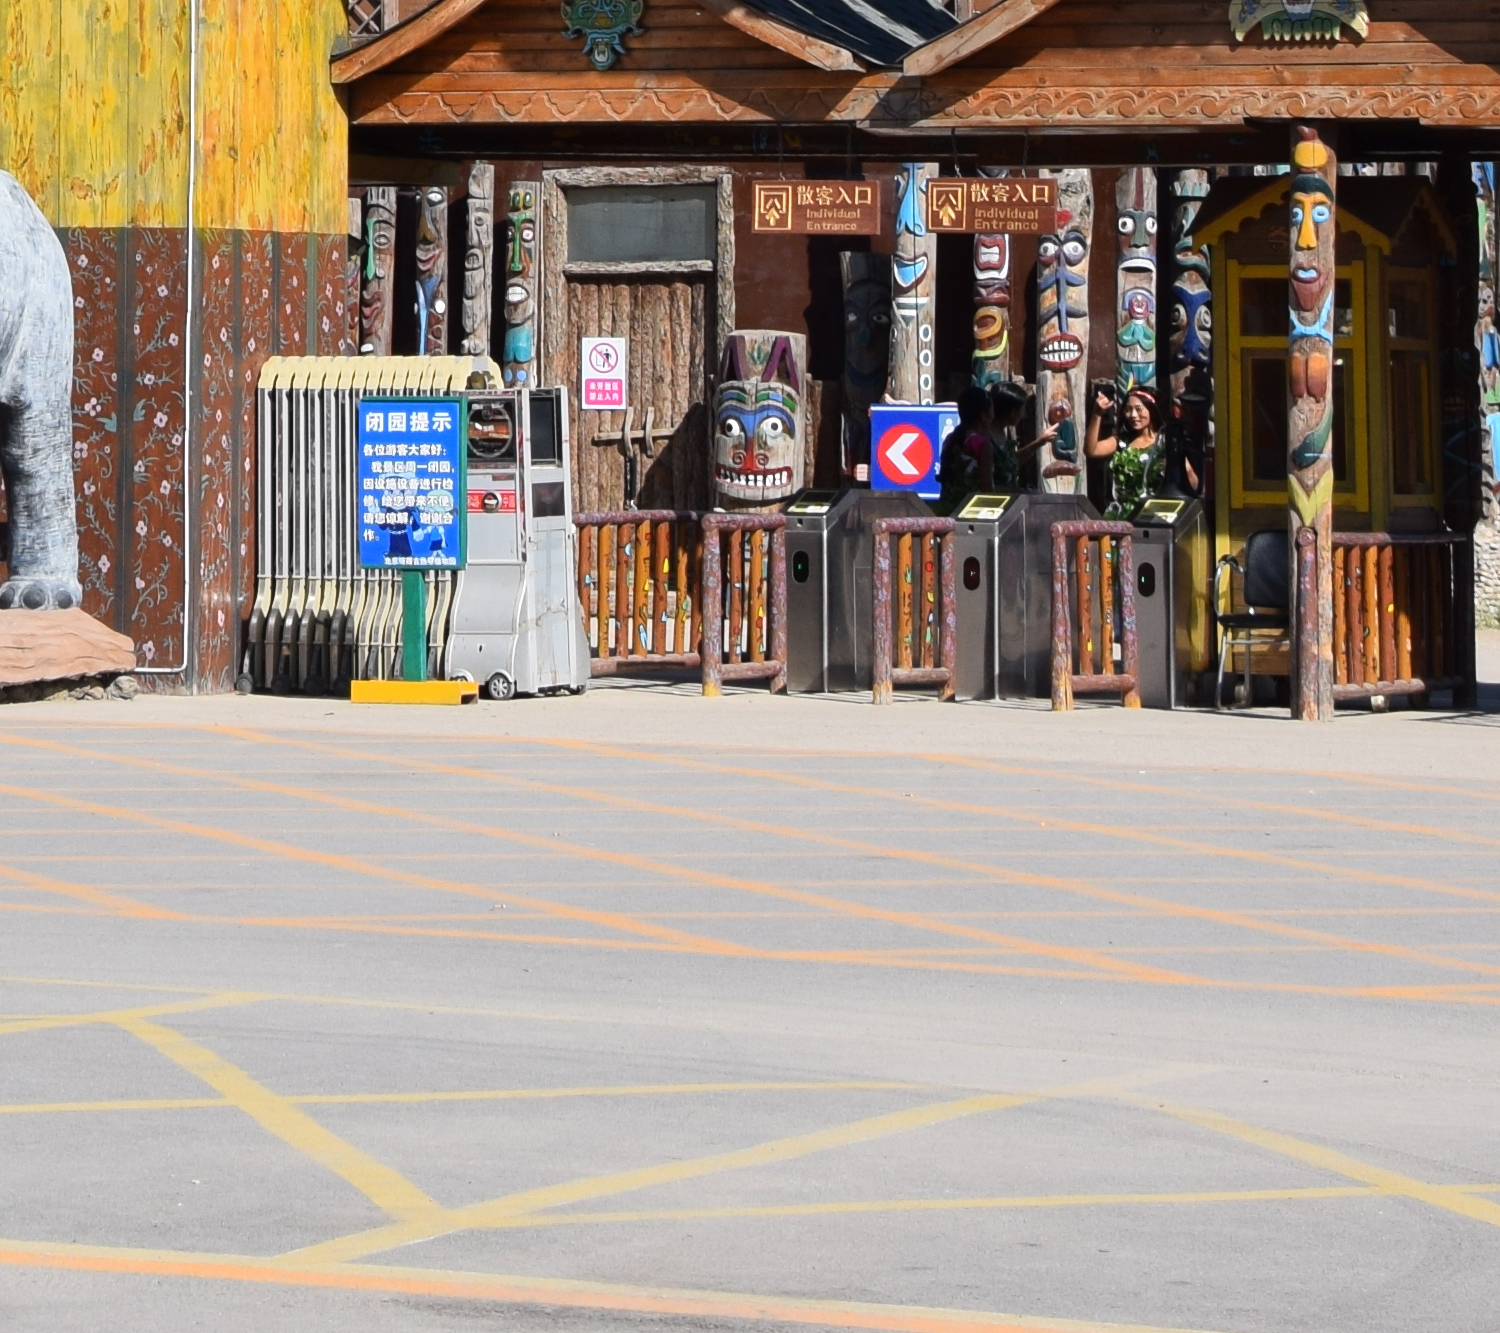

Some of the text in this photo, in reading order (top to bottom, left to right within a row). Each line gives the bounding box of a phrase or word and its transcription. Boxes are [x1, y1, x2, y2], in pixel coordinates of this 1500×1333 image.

[796, 185, 873, 206] 散客入口
[969, 182, 1050, 204] 散客入口
[806, 208, 861, 219] Individual
[974, 207, 1039, 219] Individual
[806, 220, 858, 231] Entrance
[973, 219, 1039, 230] Entrance
[365, 411, 452, 432] 闭园提示
